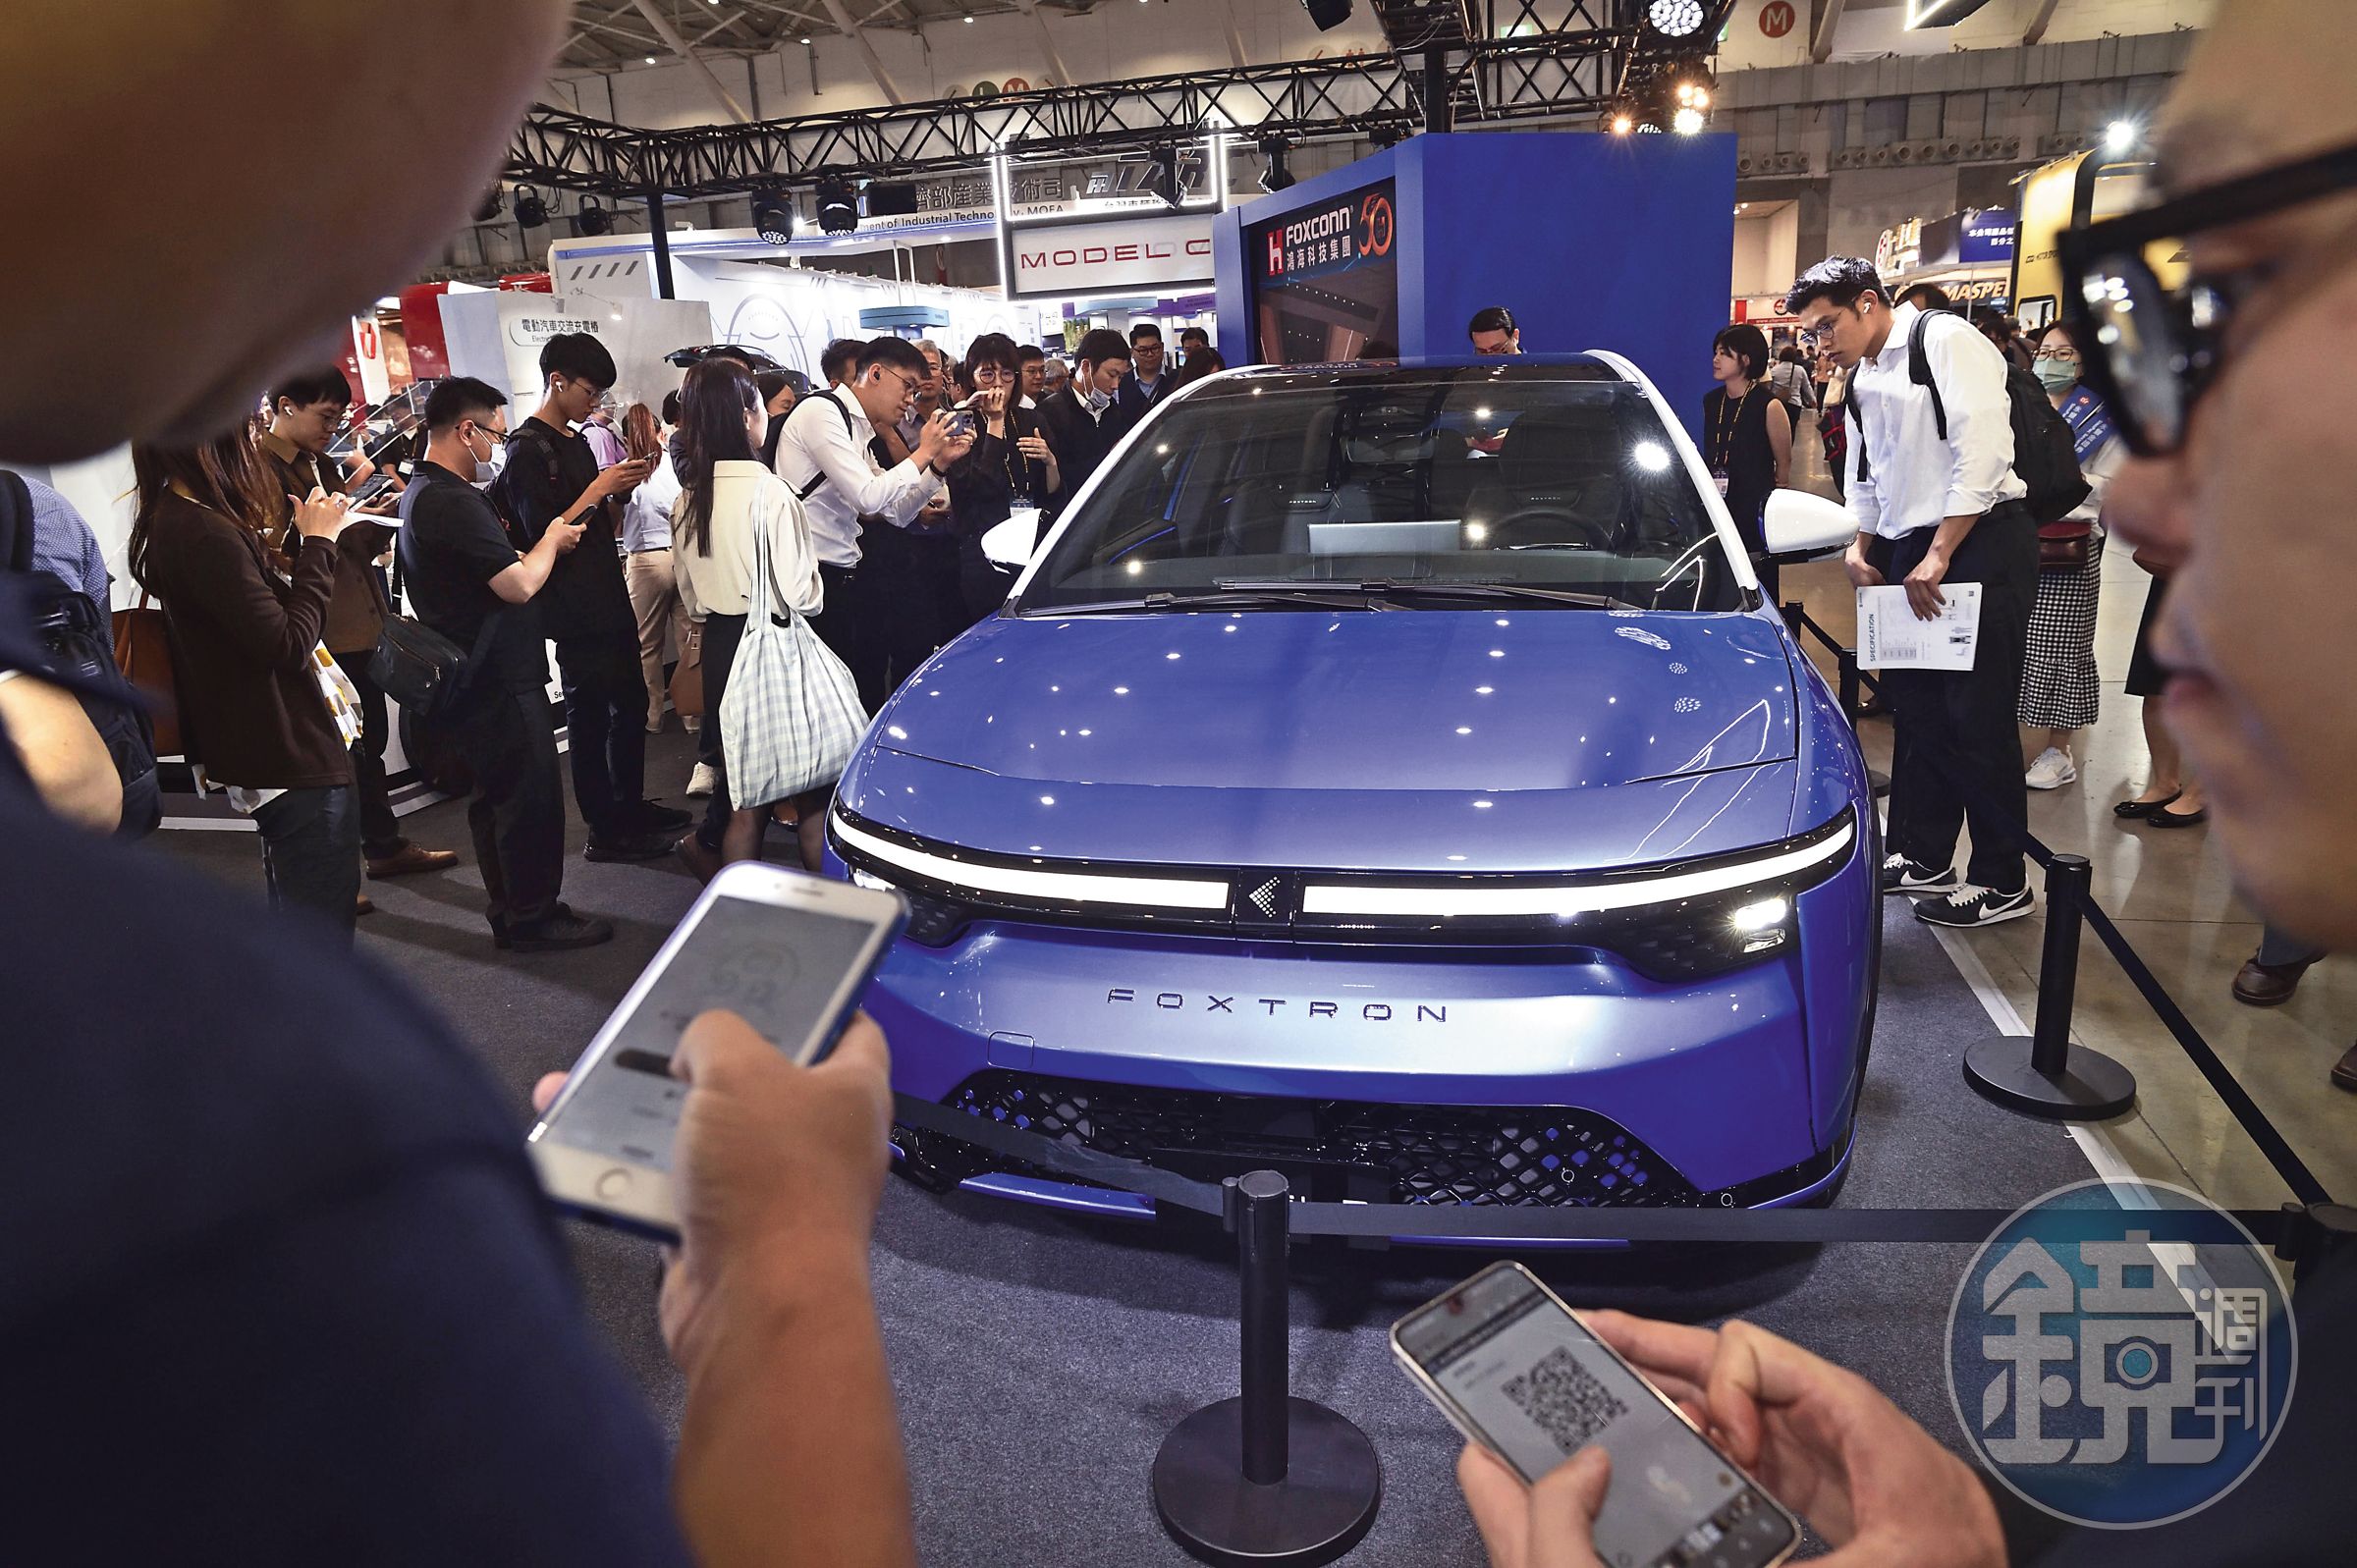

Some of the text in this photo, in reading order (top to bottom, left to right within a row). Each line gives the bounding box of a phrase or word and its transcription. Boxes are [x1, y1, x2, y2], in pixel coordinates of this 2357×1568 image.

[887, 217, 898, 229] of
[902, 212, 952, 227] Industrial
[1286, 206, 1350, 247] FOXCONN
[1021, 239, 1211, 270] MODEL C
[1287, 235, 1351, 272] 鴻海科技集團
[1868, 613, 1877, 662] SPECIFICATION
[1107, 987, 1447, 1023] FOXTRON
